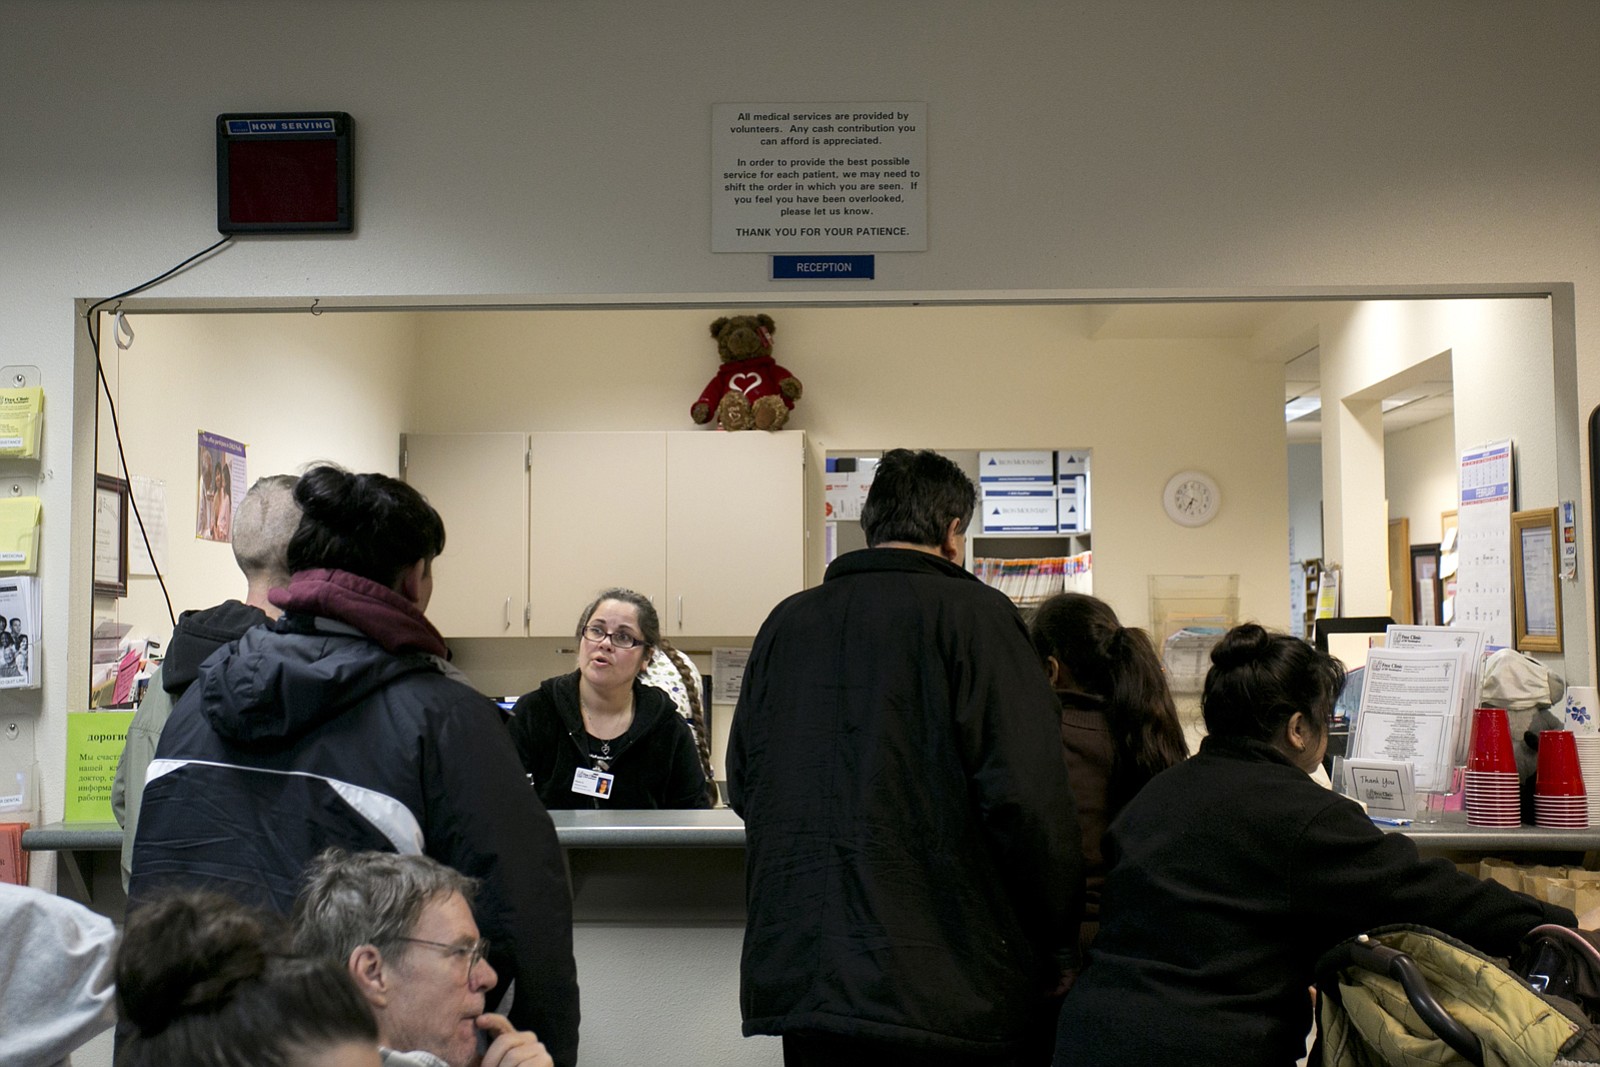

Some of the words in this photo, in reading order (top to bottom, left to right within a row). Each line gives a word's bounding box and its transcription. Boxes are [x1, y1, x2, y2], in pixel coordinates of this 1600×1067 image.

[737, 112, 750, 121] All
[753, 112, 790, 121] medical
[793, 112, 832, 120] services
[852, 112, 894, 122] provided
[897, 112, 909, 122] by
[281, 122, 331, 130] SERVING
[730, 125, 783, 133] volunteers.
[789, 124, 809, 135] Any
[812, 124, 834, 133] cash
[837, 124, 895, 132] contribution
[898, 125, 916, 134] you
[780, 136, 809, 145] afford
[812, 136, 820, 145] is
[823, 136, 882, 147] appreciated.
[737, 158, 746, 166] In
[749, 158, 774, 166] order
[790, 158, 826, 168] provide
[828, 158, 844, 166] the
[847, 158, 868, 166] best
[871, 157, 910, 168] possible
[723, 170, 757, 179] service
[760, 170, 774, 179] for
[776, 170, 800, 179] each
[802, 170, 839, 181] patient,
[860, 172, 880, 180] may
[883, 169, 907, 178] need
[724, 182, 746, 191] shift
[749, 183, 764, 191] the
[767, 182, 792, 191] order
[795, 182, 804, 191] in
[807, 182, 836, 191] which
[839, 184, 857, 192] you
[910, 181, 918, 190] If
[734, 197, 752, 205] you
[755, 195, 773, 204] feel
[776, 196, 794, 205] you
[796, 195, 820, 203] have
[822, 194, 846, 203] been
[848, 194, 904, 203] overlooked,
[780, 207, 811, 218] please
[814, 207, 826, 216] let
[844, 207, 874, 215] know.
[736, 228, 771, 236] THANK
[774, 228, 797, 236] YOU
[800, 228, 821, 236] FOR
[824, 227, 853, 236] YOUR
[856, 227, 910, 236] PATIENCE.
[796, 262, 852, 272] RECEPTION
[1382, 777, 1394, 788] You
